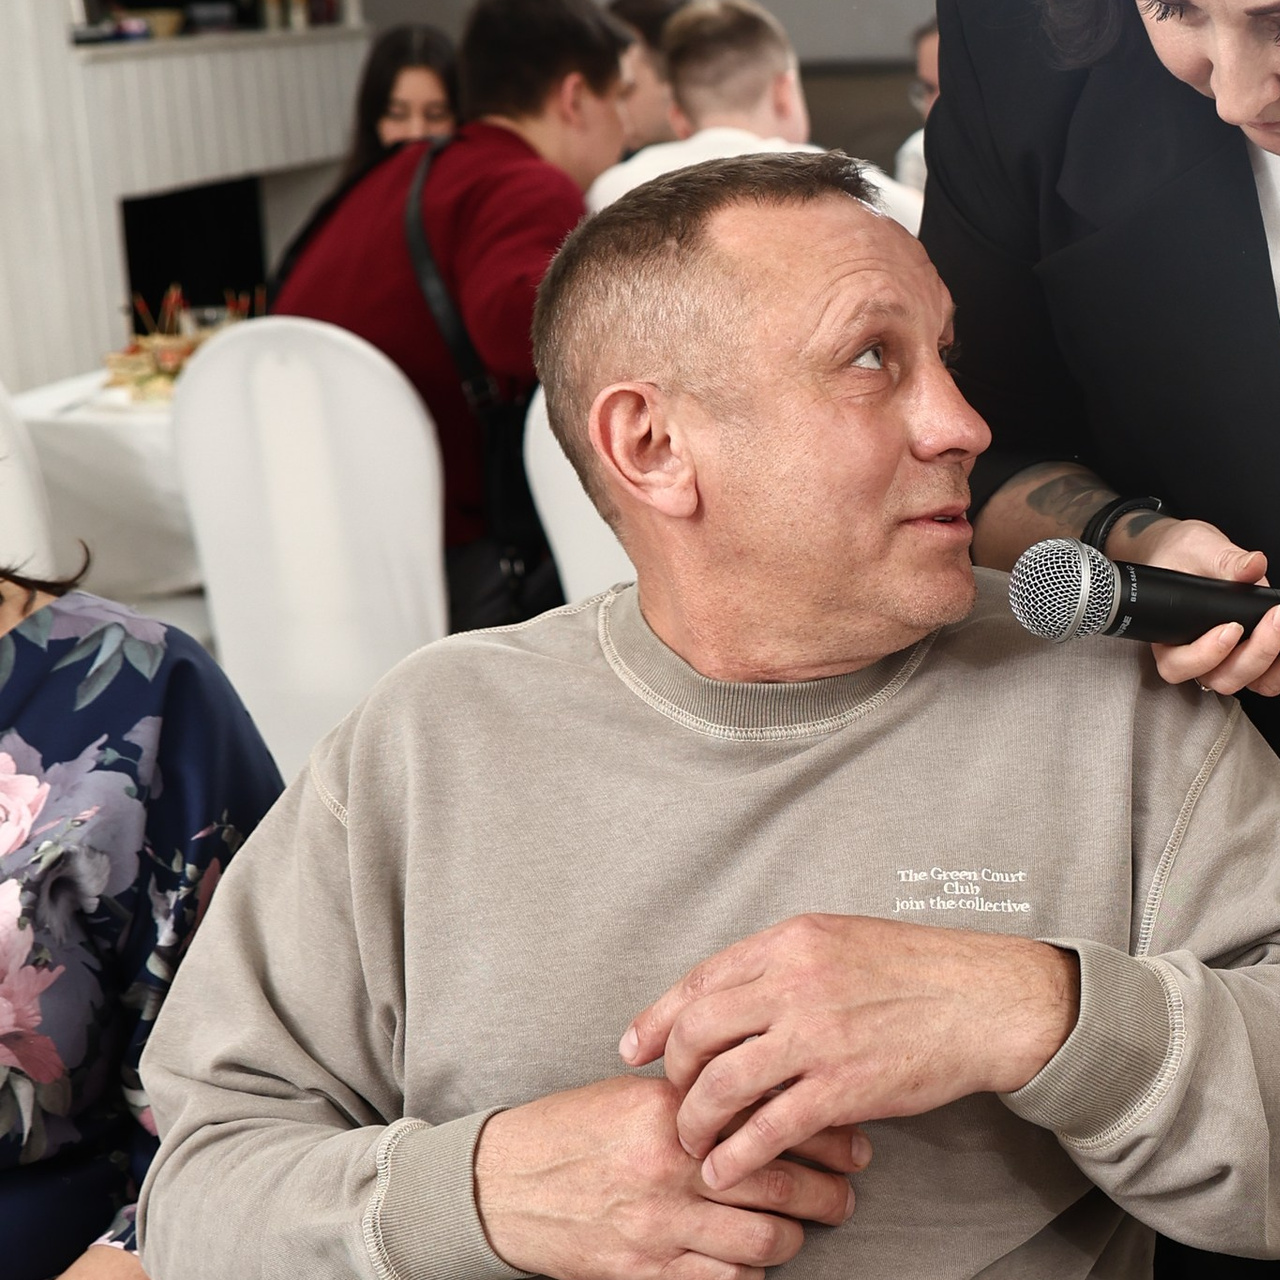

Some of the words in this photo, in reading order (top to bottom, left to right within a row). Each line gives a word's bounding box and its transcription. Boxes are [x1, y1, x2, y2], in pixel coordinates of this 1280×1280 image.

[1130, 582, 1138, 603] BETA
[897, 869, 928, 882] The
[930, 867, 979, 882] Green
[981, 868, 1027, 883] Court
[943, 882, 981, 895] Club
[893, 897, 925, 913] join
[929, 896, 956, 910] the
[958, 897, 1031, 913] collective
